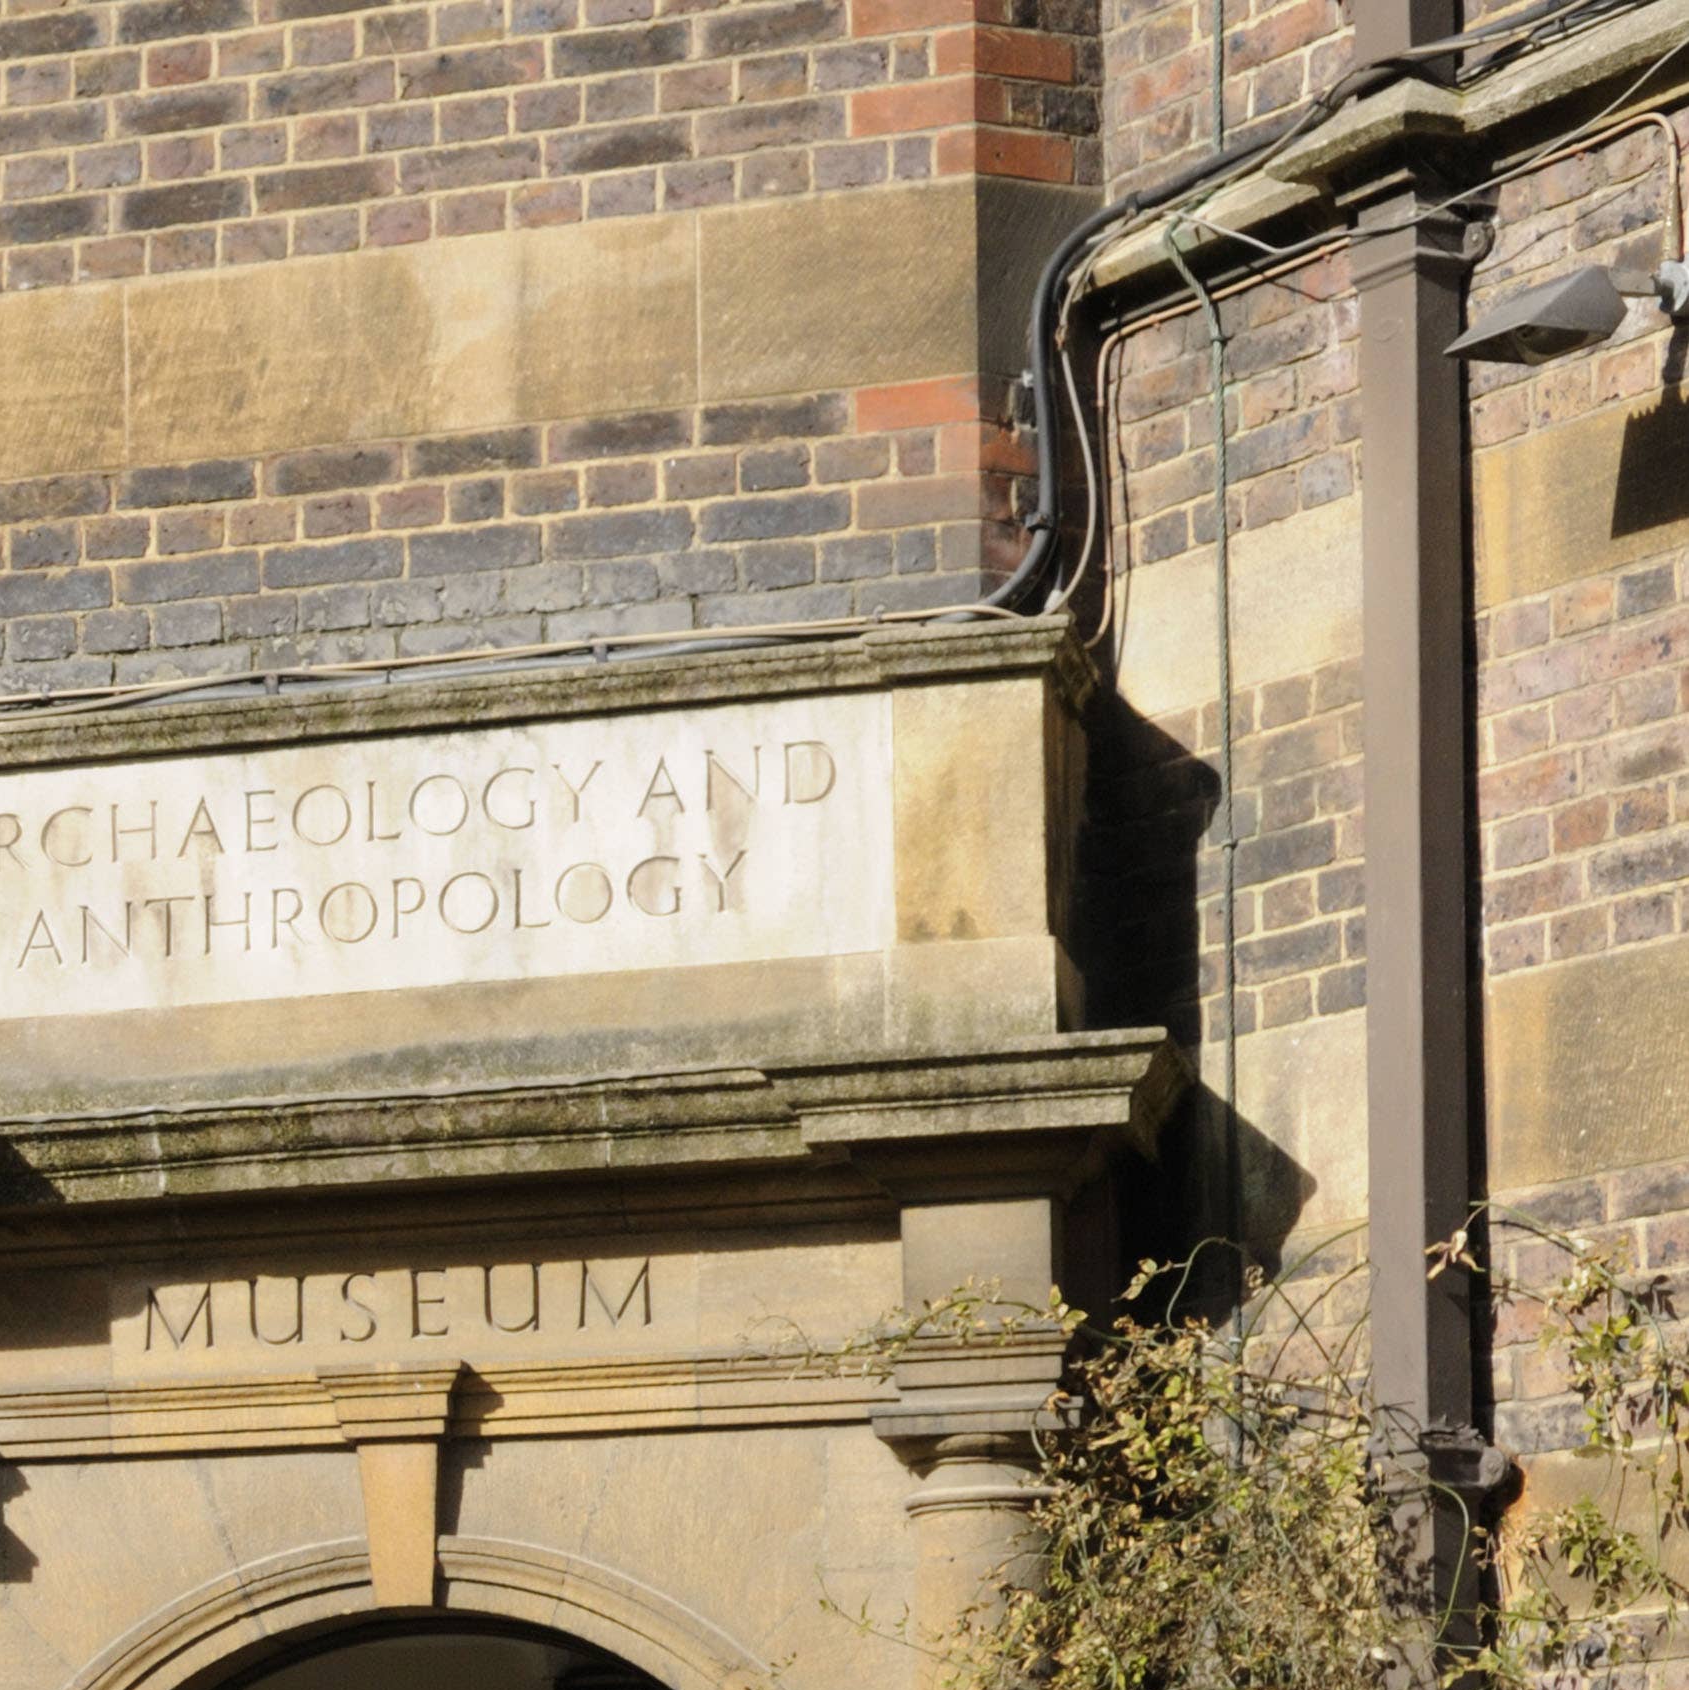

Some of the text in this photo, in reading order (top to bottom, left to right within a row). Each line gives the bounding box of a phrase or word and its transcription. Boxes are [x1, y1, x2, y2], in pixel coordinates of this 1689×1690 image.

[636, 740, 837, 819] AND
[17, 850, 748, 969] ANTHROPOLOGY
[143, 1257, 650, 1351] MUSEUM
